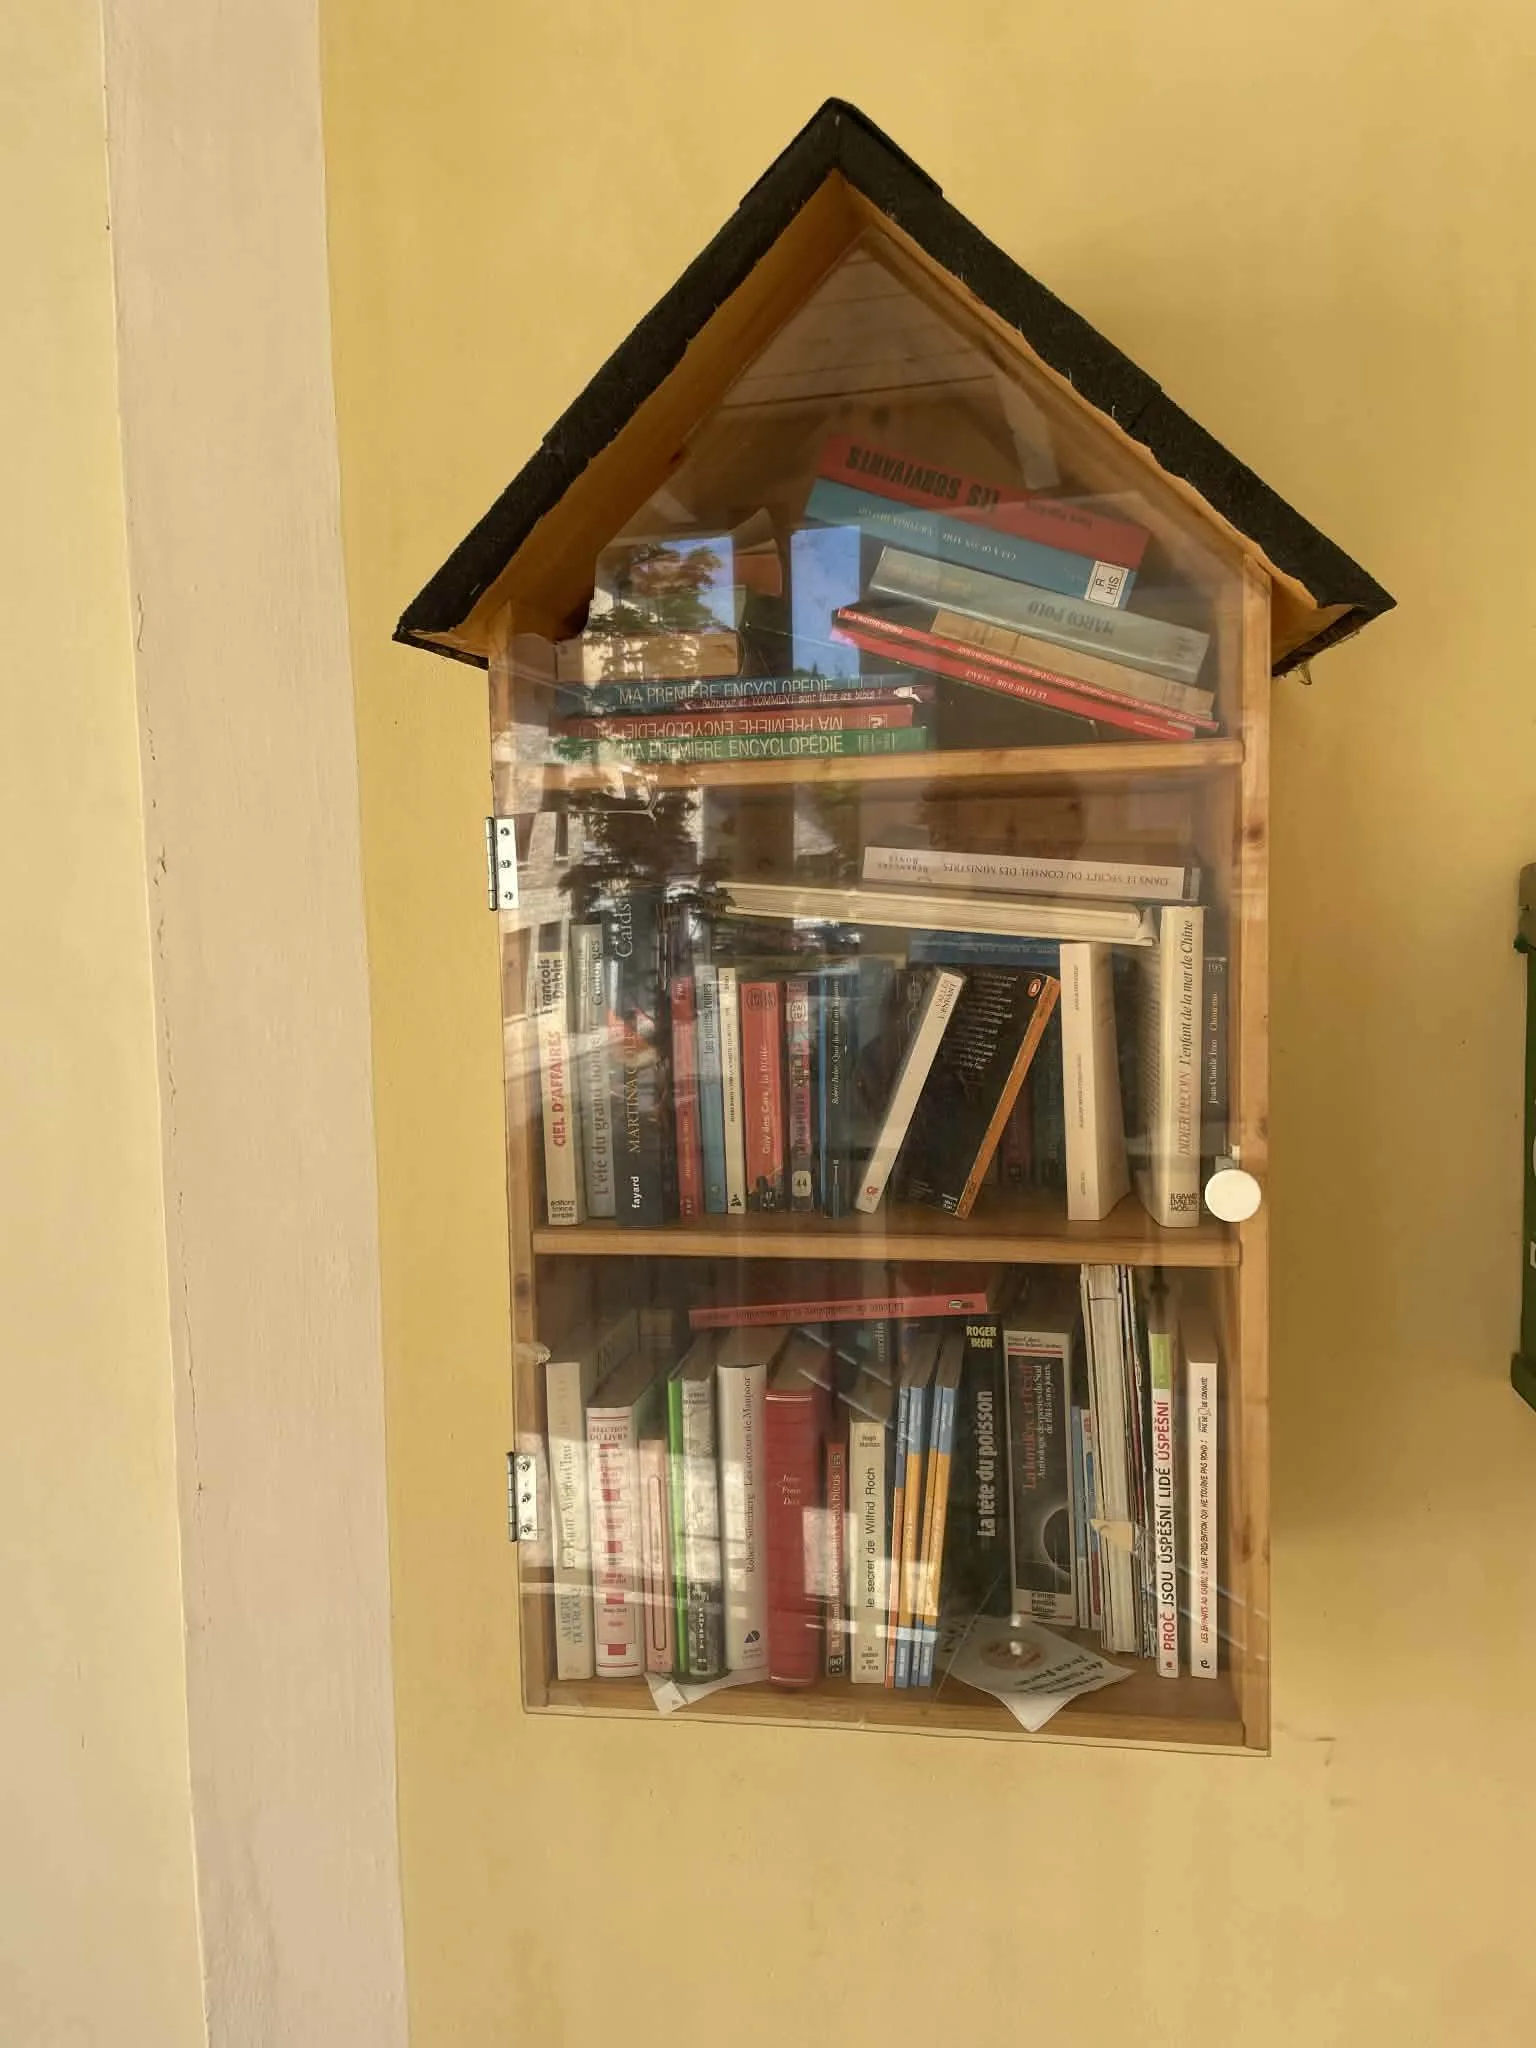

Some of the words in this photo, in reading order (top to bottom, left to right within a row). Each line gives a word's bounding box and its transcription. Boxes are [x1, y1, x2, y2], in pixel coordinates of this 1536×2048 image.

[846, 446, 961, 501] SURVIVANTS
[966, 484, 999, 512] LES
[1095, 577, 1106, 588] R
[1105, 575, 1120, 596] HIS
[1027, 600, 1064, 623] POLO
[1066, 608, 1117, 638] MARCO
[752, 693, 796, 708] COMMENT
[819, 716, 843, 731] MA
[942, 860, 998, 877] MINISTRES
[999, 864, 1020, 878] DES
[1065, 869, 1083, 881] DU
[1181, 920, 1193, 954] Chine
[1180, 955, 1193, 970] de
[1183, 970, 1193, 993] mer
[1180, 993, 1192, 1006] la
[1180, 1008, 1192, 1021] de
[551, 1117, 566, 1148] CIEL
[591, 1136, 606, 1155] du
[762, 1135, 773, 1155] Guy
[630, 1175, 642, 1209] fayard
[966, 1326, 997, 1337] ROGER
[1032, 1365, 1042, 1383] Sud
[743, 1419, 752, 1432] de
[975, 1390, 998, 1455] poisson
[1154, 1400, 1170, 1461] ÚSPĚŠNÍ
[976, 1457, 995, 1482] du
[865, 1467, 875, 1496] Roch
[1155, 1467, 1171, 1499] LIDÉ
[977, 1484, 995, 1516] tête
[865, 1501, 875, 1535] Wilfrid
[977, 1518, 996, 1537] La
[1157, 1504, 1173, 1563] ÚSPĚŠNÍ
[865, 1540, 875, 1554] de
[865, 1559, 875, 1593] secret
[1162, 1571, 1175, 1607] JSOU
[866, 1598, 875, 1608] le
[1160, 1611, 1176, 1650] PROČ
